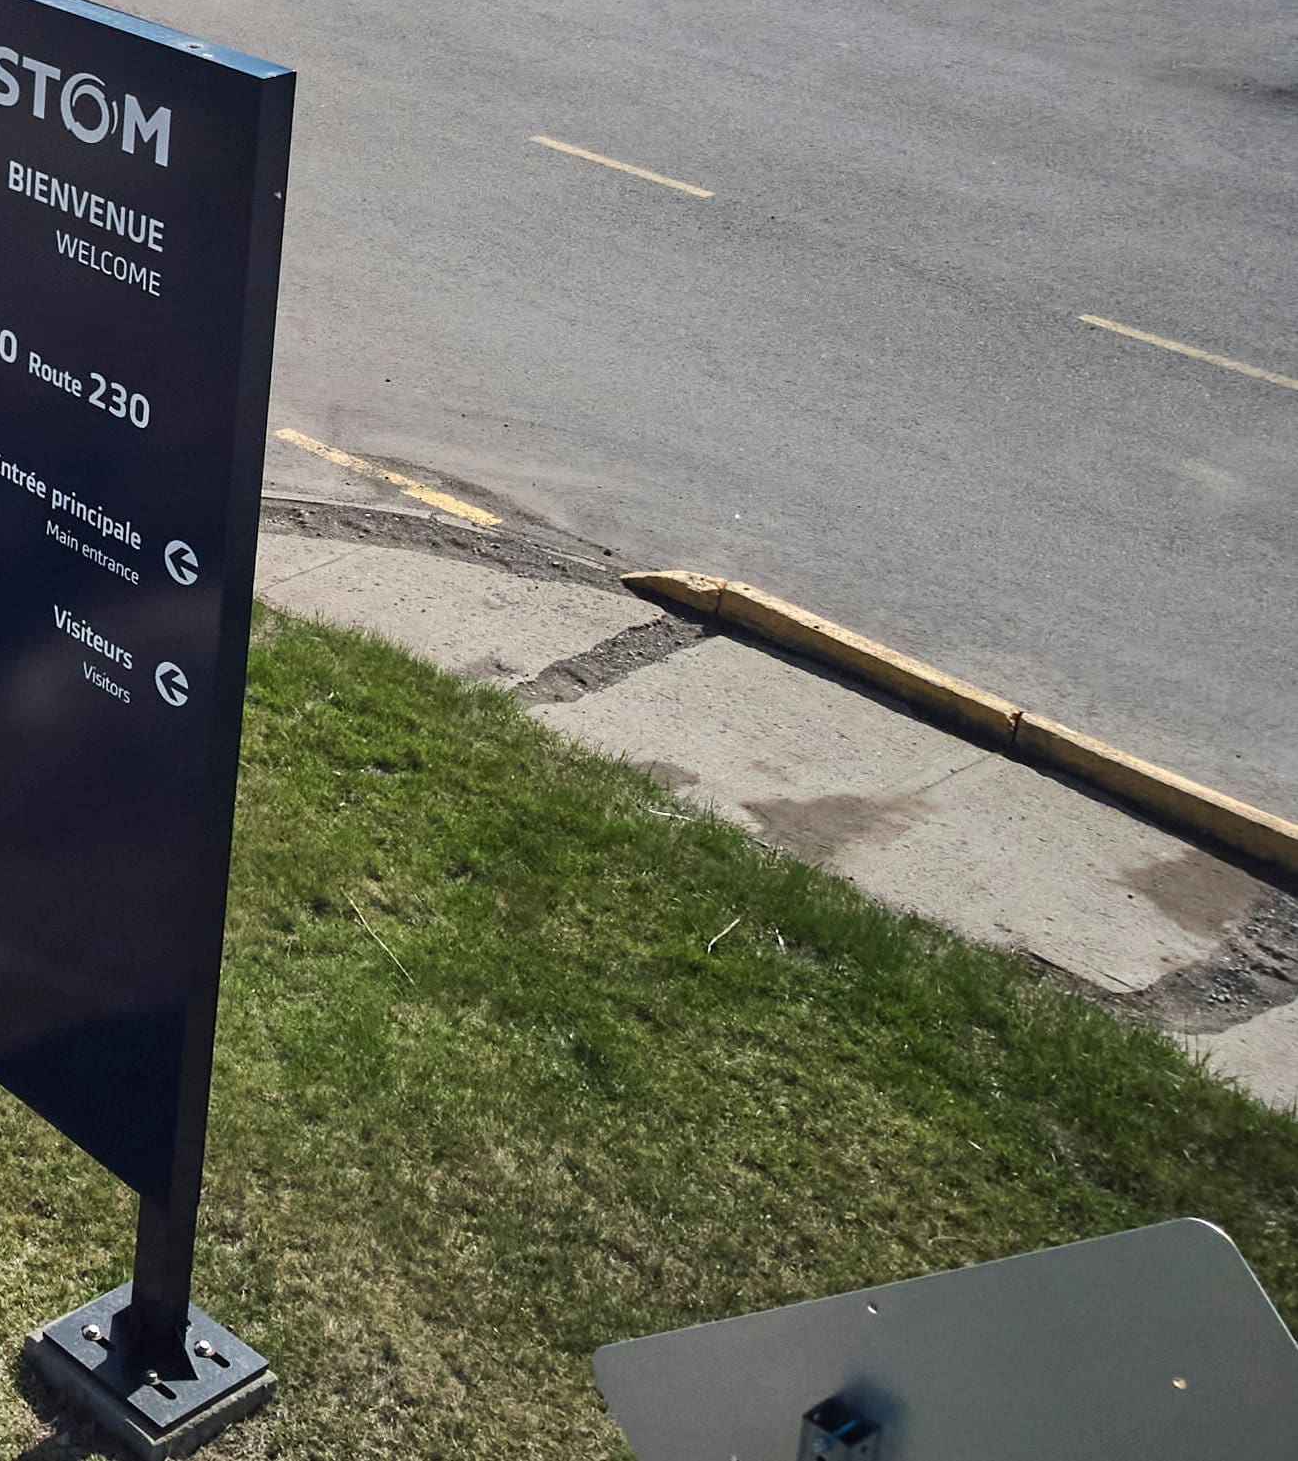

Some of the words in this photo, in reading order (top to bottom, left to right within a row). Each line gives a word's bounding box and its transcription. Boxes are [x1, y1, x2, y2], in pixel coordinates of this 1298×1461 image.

[8, 159, 165, 253] BIENVENUE
[56, 228, 162, 297] WELCOME
[28, 351, 83, 398] Route
[88, 372, 150, 429] 230
[51, 488, 142, 550] principale
[46, 520, 79, 552] Main
[81, 543, 140, 586] entrance
[53, 604, 133, 670] Visiteurs
[83, 660, 132, 704] Visitors
